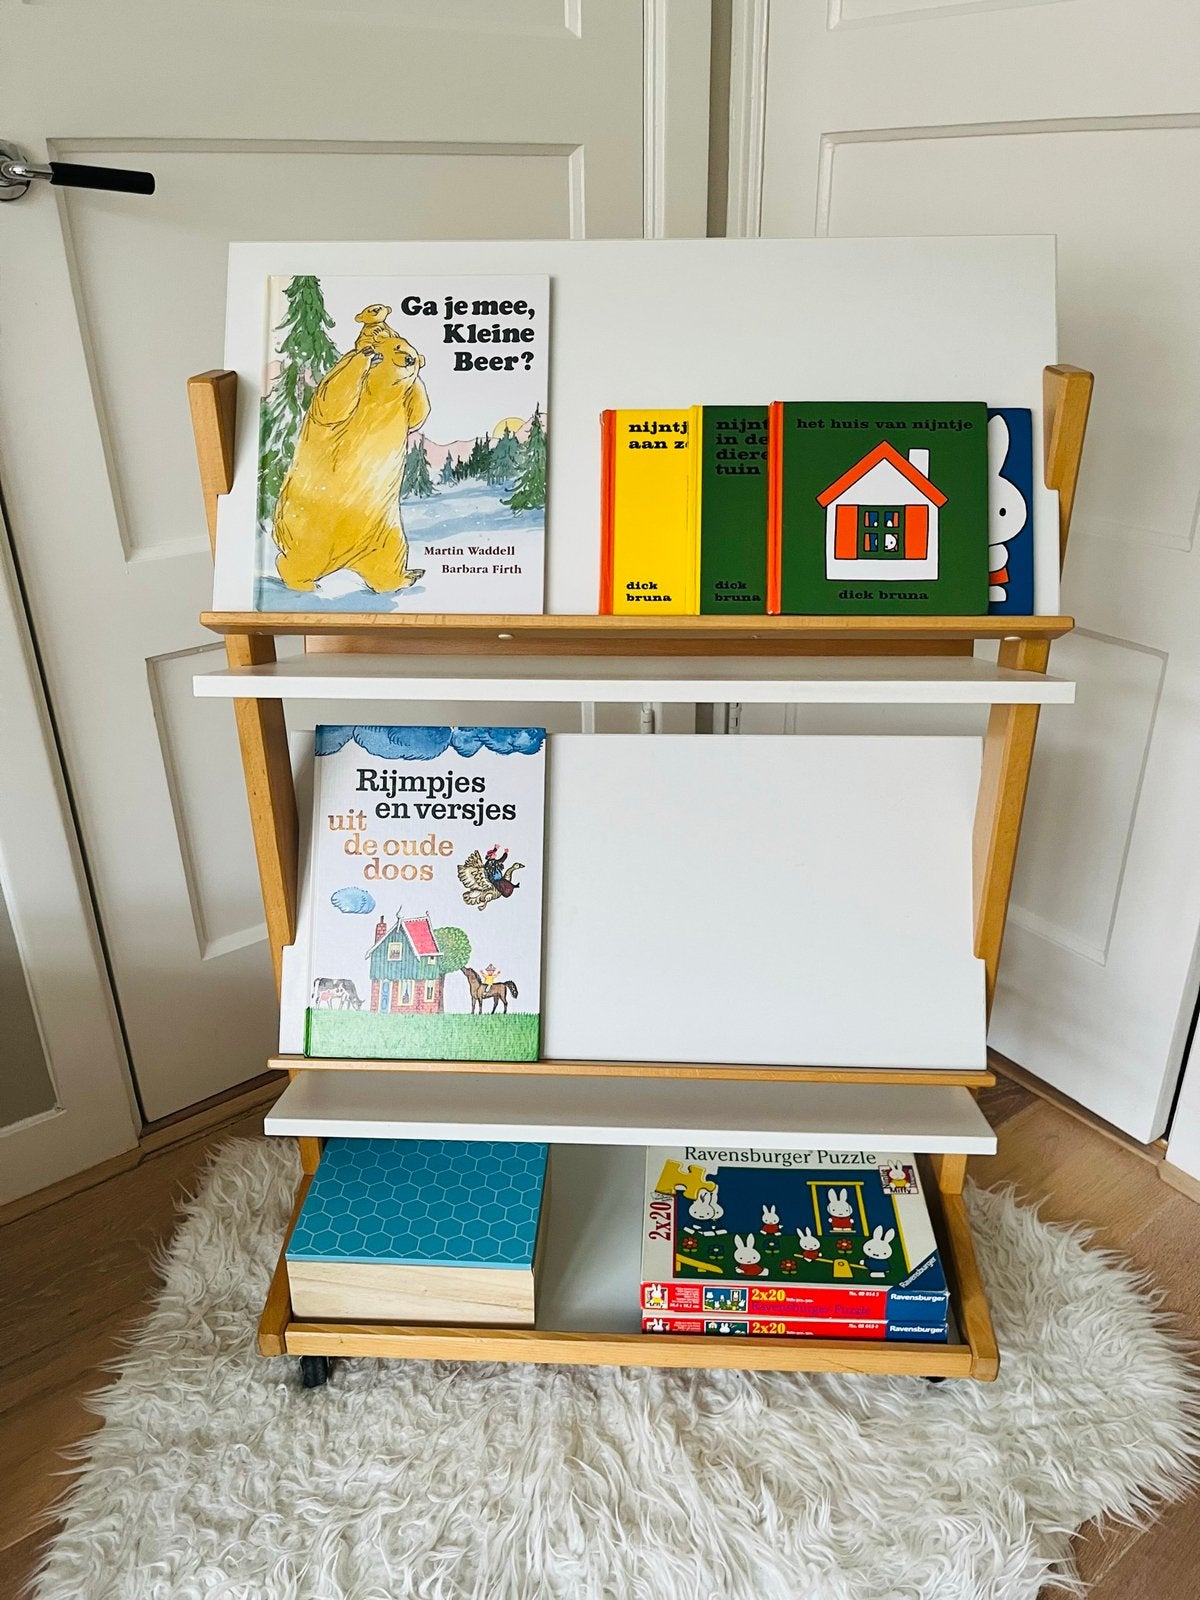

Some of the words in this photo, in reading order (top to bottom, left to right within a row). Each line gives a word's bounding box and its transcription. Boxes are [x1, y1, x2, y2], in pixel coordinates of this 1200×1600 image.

[401, 296, 438, 316] Ga
[444, 296, 468, 320] je
[472, 300, 535, 320] mee,
[443, 324, 535, 343] Kleine
[453, 351, 535, 371] Beer?
[796, 418, 825, 429] het
[831, 418, 869, 429] huis
[875, 421, 906, 429] van
[912, 419, 973, 431] nijntje
[628, 440, 668, 449] aan
[674, 440, 688, 449] z
[715, 433, 738, 445] in
[745, 433, 768, 445] de
[715, 463, 761, 475] tuin
[424, 546, 464, 555] Martin
[468, 546, 515, 555] Waddell
[442, 565, 488, 574] Barbara
[493, 565, 522, 574] Firth
[626, 582, 658, 590] dick
[715, 581, 747, 590] dick
[626, 593, 672, 601] bruna
[715, 593, 761, 601] bruna
[838, 590, 874, 599] dick
[879, 590, 929, 600] bruna
[356, 768, 486, 799] Rijmpjes
[375, 802, 411, 819] en
[414, 798, 517, 826] versjes
[328, 809, 368, 831] uit
[344, 833, 378, 856] de
[383, 833, 454, 856] oude
[363, 858, 434, 881] doos
[685, 1146, 811, 1167] Ravensburger
[817, 1149, 877, 1164] Puzzle
[649, 1201, 671, 1241] 2x20
[899, 1256, 937, 1288] Ravensburger
[751, 1289, 786, 1301] 2x20
[890, 1293, 946, 1302] Ravensburger
[752, 1322, 786, 1335] 2x20
[889, 1325, 945, 1334] Ravensburger
